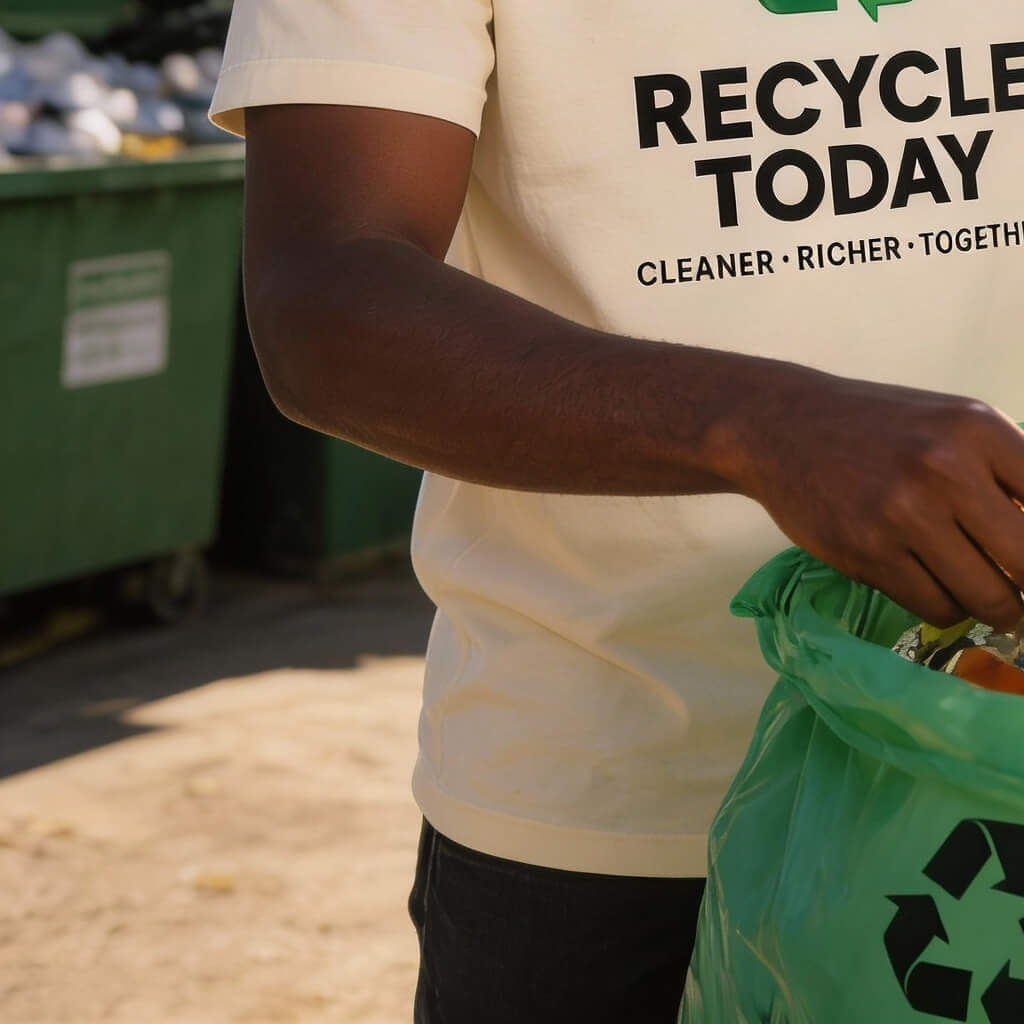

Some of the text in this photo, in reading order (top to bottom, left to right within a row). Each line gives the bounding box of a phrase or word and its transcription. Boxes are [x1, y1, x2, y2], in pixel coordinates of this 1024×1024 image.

[694, 129, 994, 228] TODAY
[637, 249, 774, 287] CLEANER
[797, 236, 902, 271] RICHER
